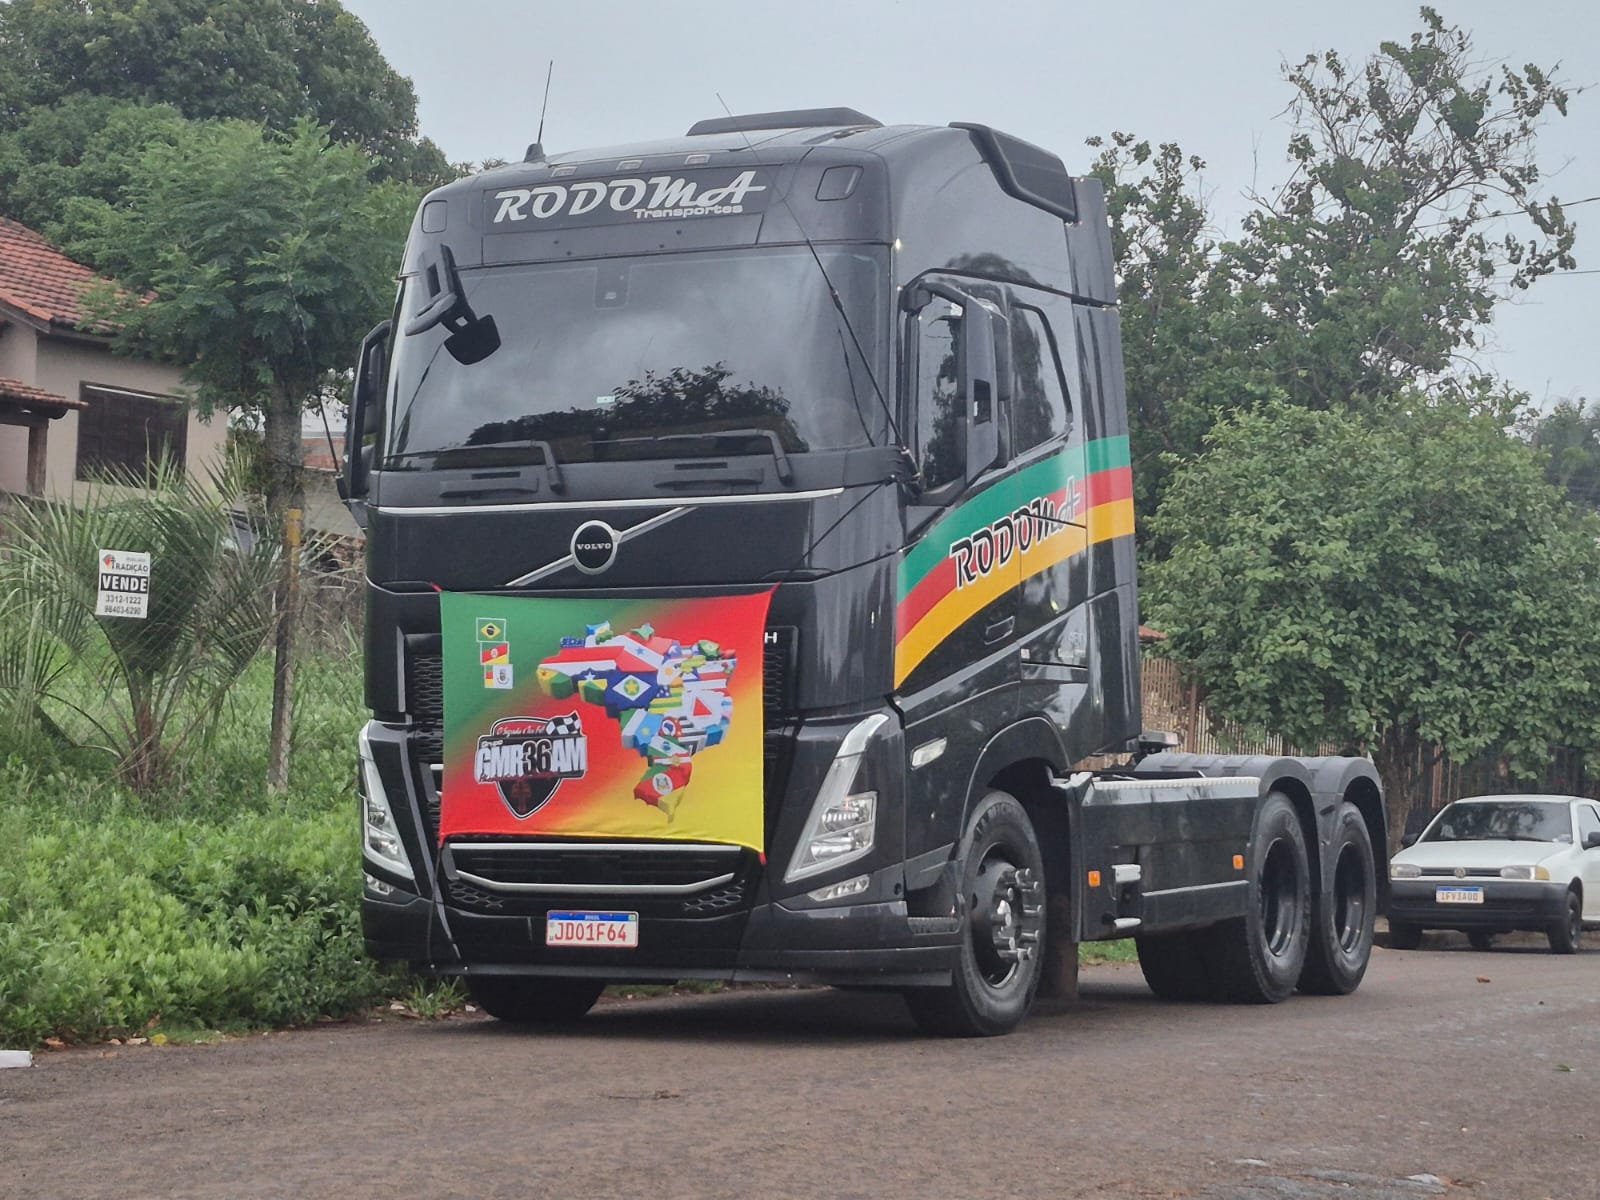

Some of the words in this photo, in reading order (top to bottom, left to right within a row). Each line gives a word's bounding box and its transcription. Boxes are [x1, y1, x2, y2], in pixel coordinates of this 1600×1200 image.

[633, 204, 743, 219] Transportes
[576, 542, 612, 550] VOLVO
[102, 575, 147, 591] VENDE
